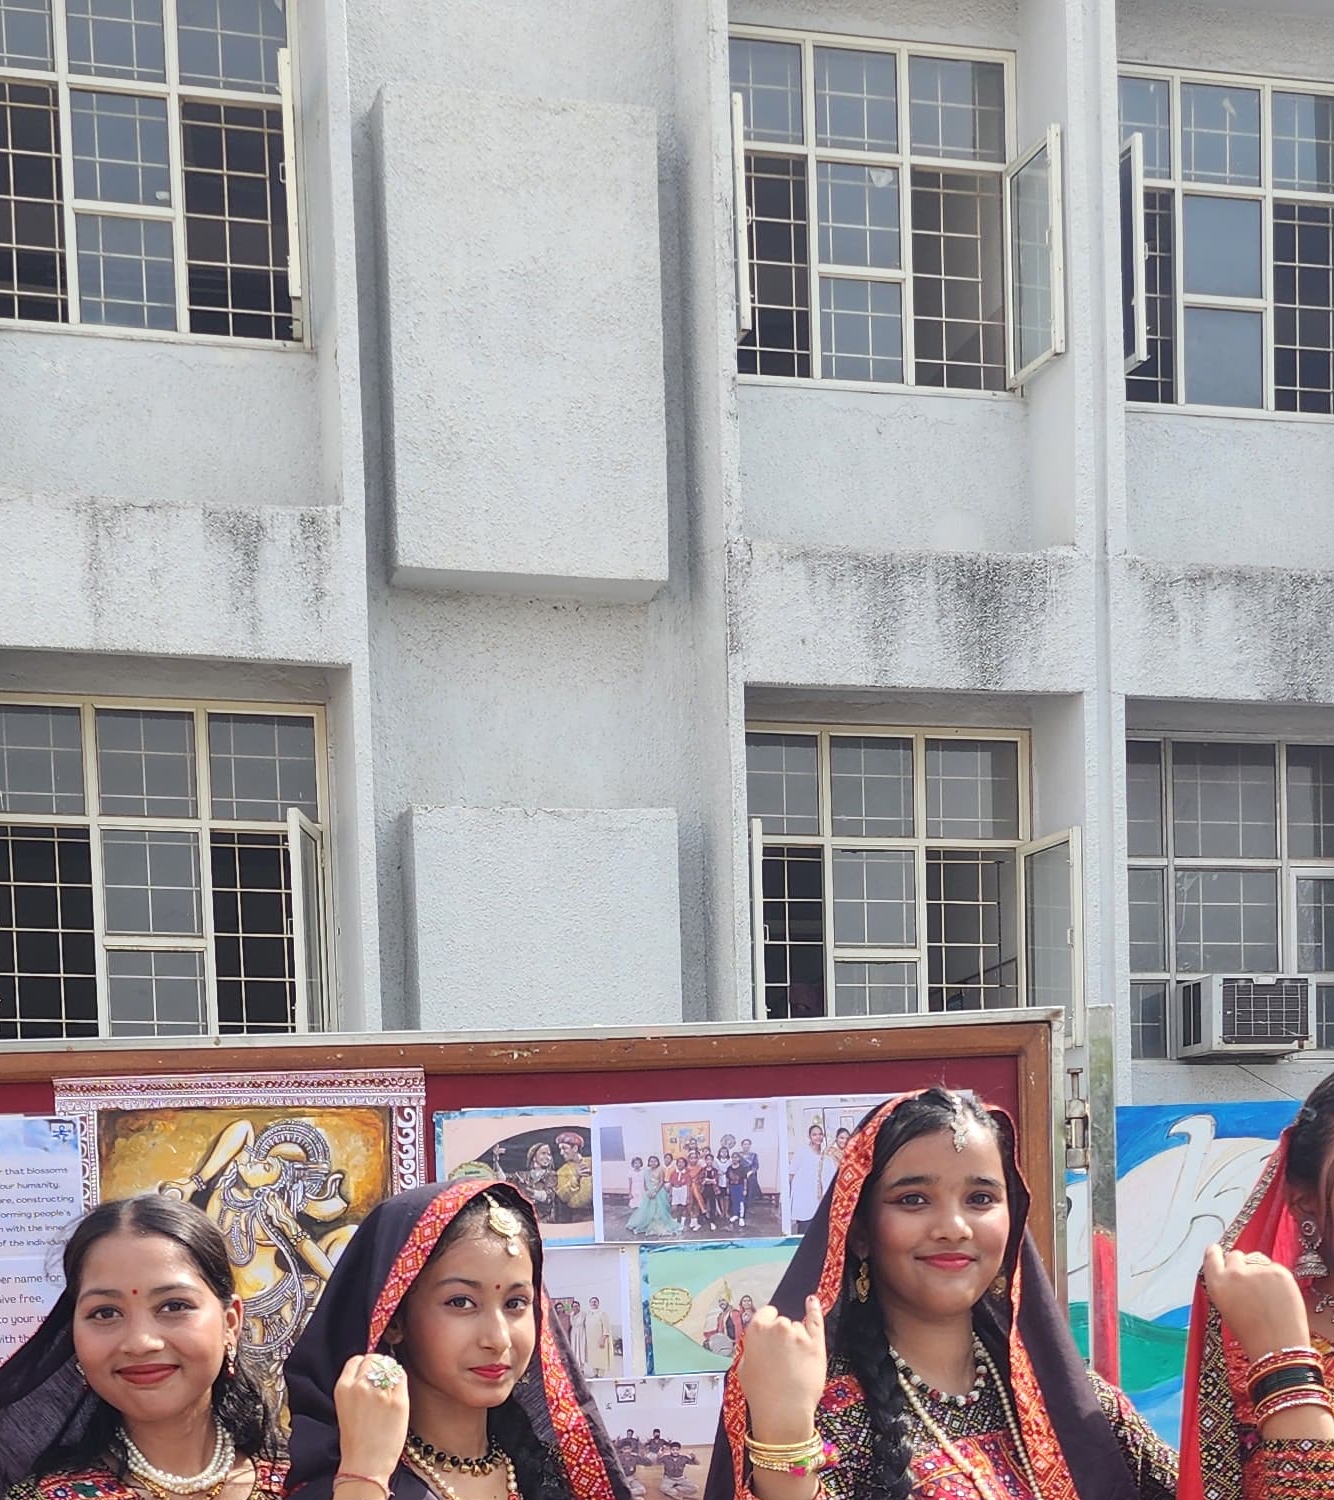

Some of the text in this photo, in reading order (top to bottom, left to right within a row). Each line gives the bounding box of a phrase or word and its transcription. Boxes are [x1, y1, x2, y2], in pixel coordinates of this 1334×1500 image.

[16, 1195, 74, 1204] constructing
[1131, 1112, 1279, 1277] K
[14, 1275, 42, 1283] name
[46, 1273, 61, 1282] for
[11, 1316, 34, 1326] your
[19, 1334, 32, 1343] th
